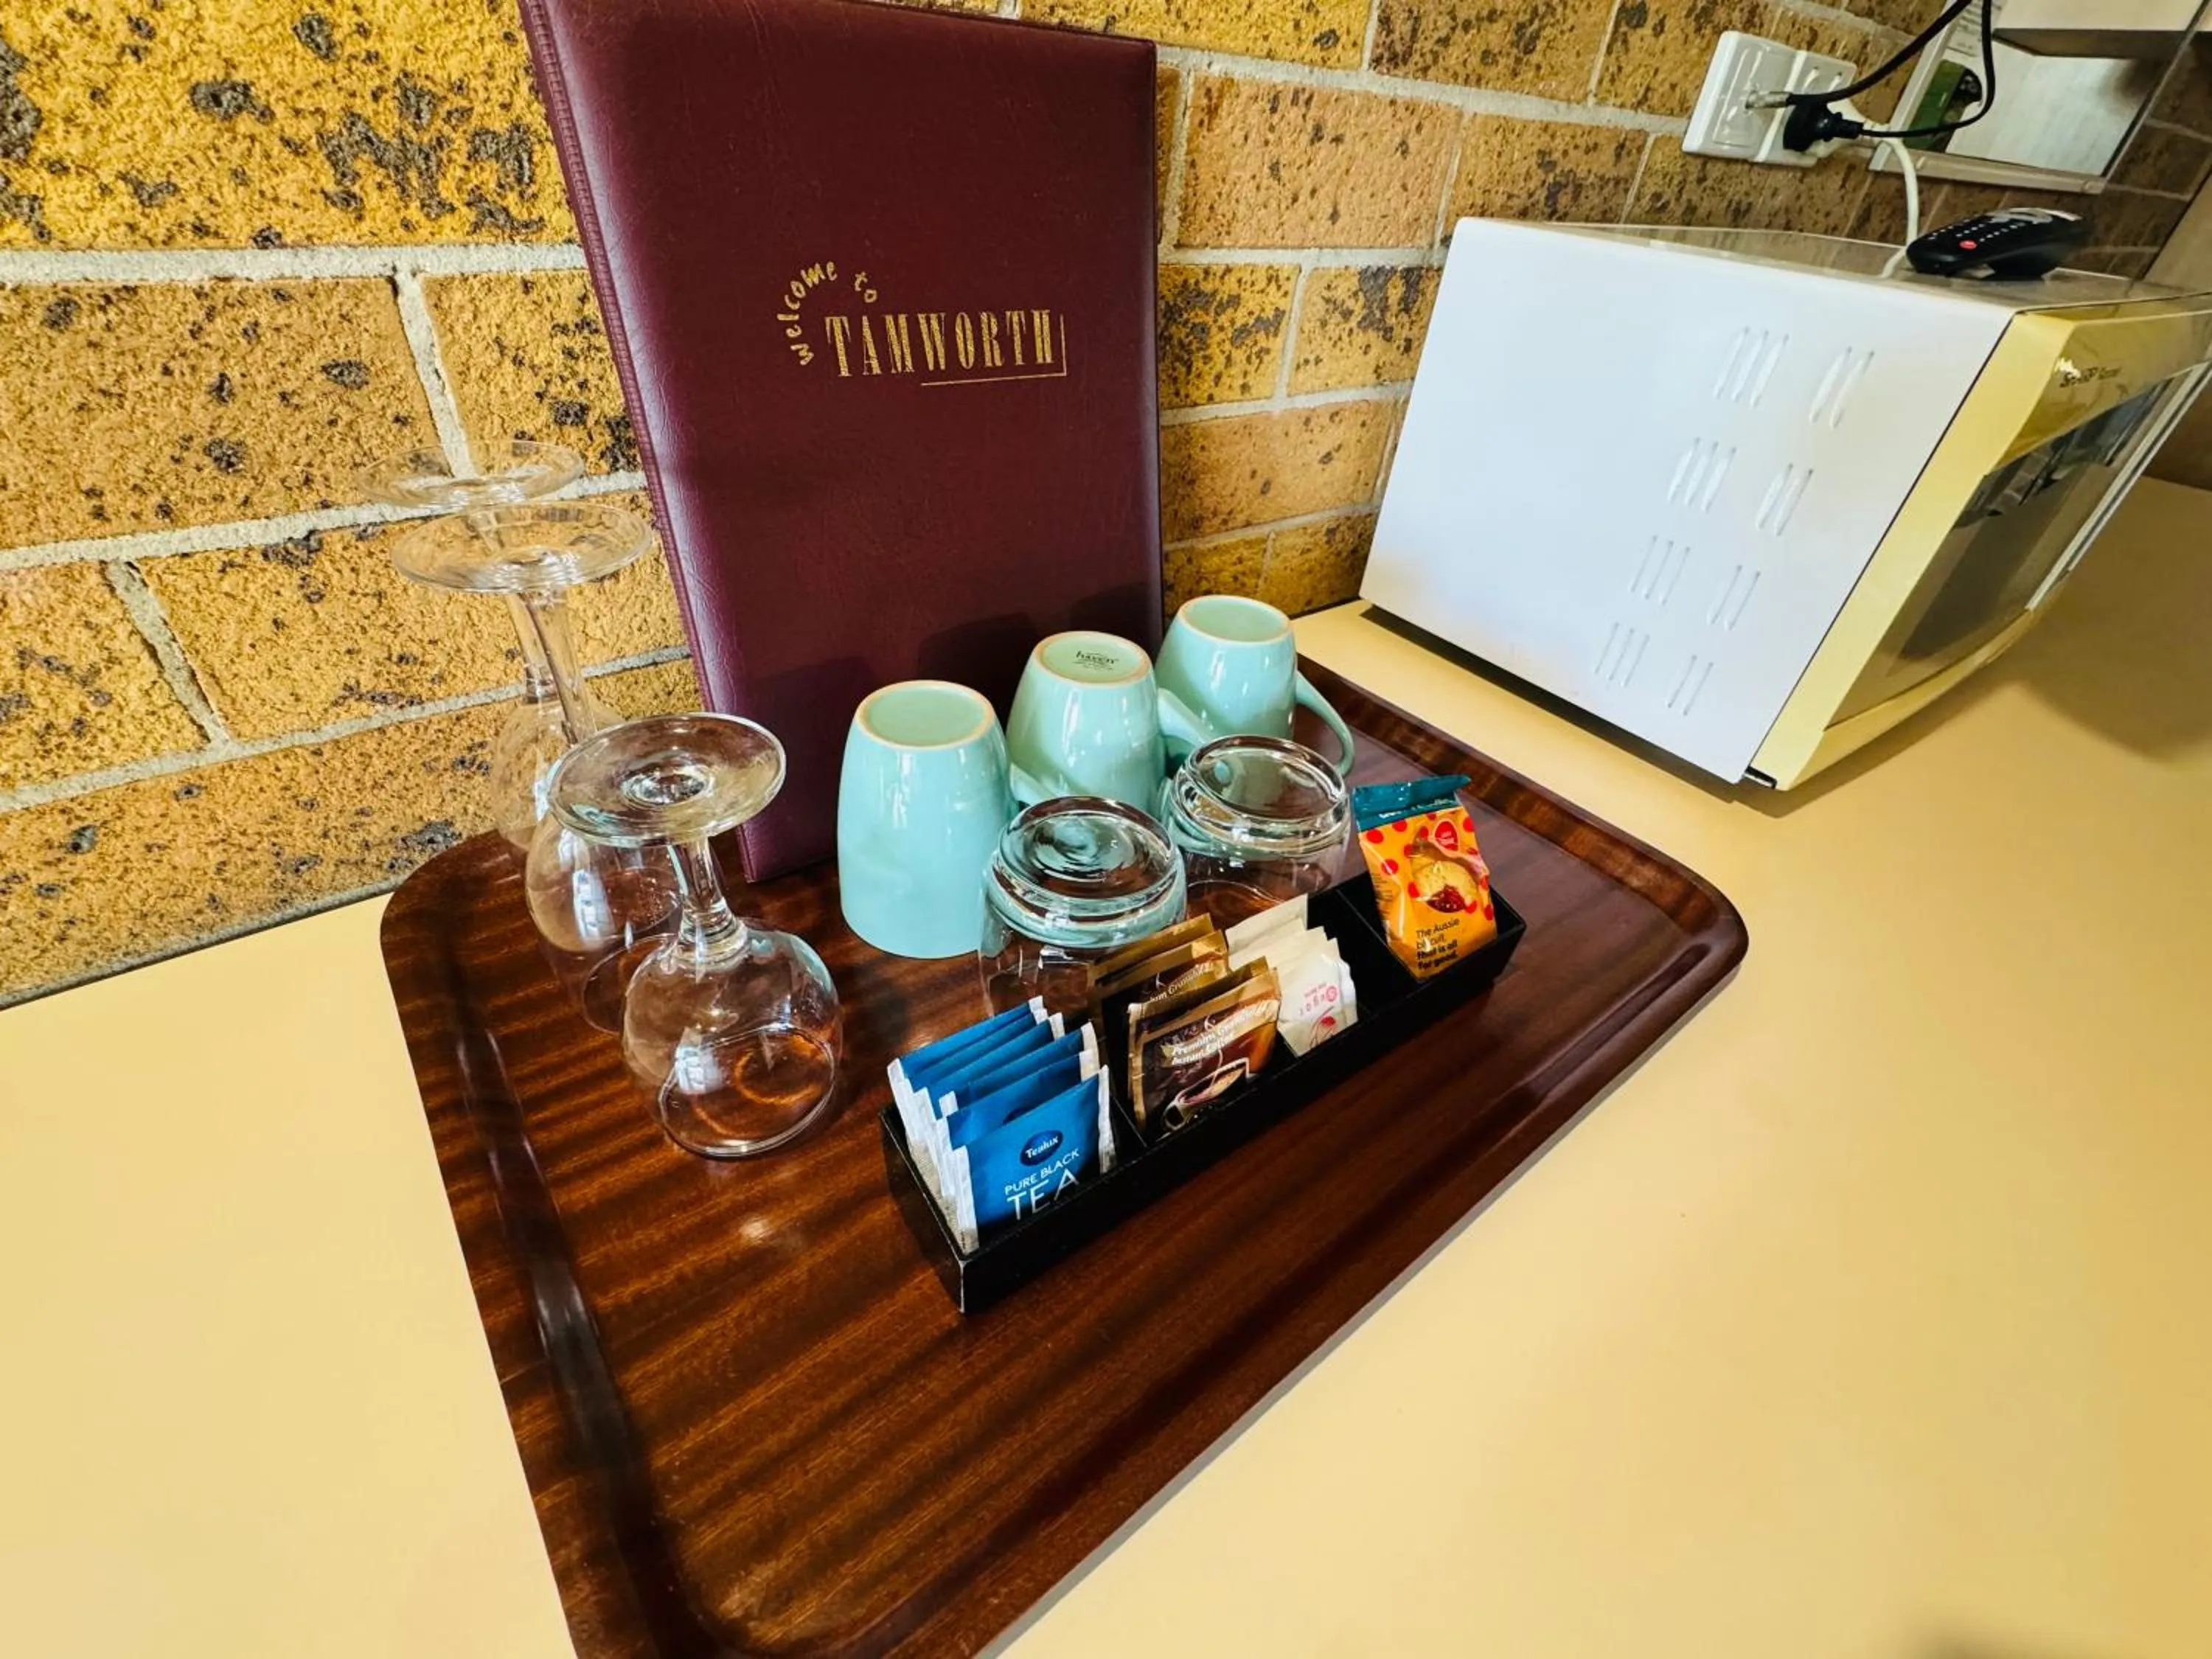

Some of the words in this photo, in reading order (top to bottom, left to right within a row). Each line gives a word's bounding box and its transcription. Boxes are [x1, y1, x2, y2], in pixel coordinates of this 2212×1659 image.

[776, 261, 838, 366] welcome
[854, 271, 878, 304] to
[824, 308, 1054, 378] TAMWORTH
[1433, 918, 1460, 934] Aussie
[1004, 1172, 1038, 1196] PURE
[1040, 1147, 1079, 1180] BLACK
[1025, 1135, 1059, 1158] Tealux
[1006, 1167, 1080, 1221] TEA
